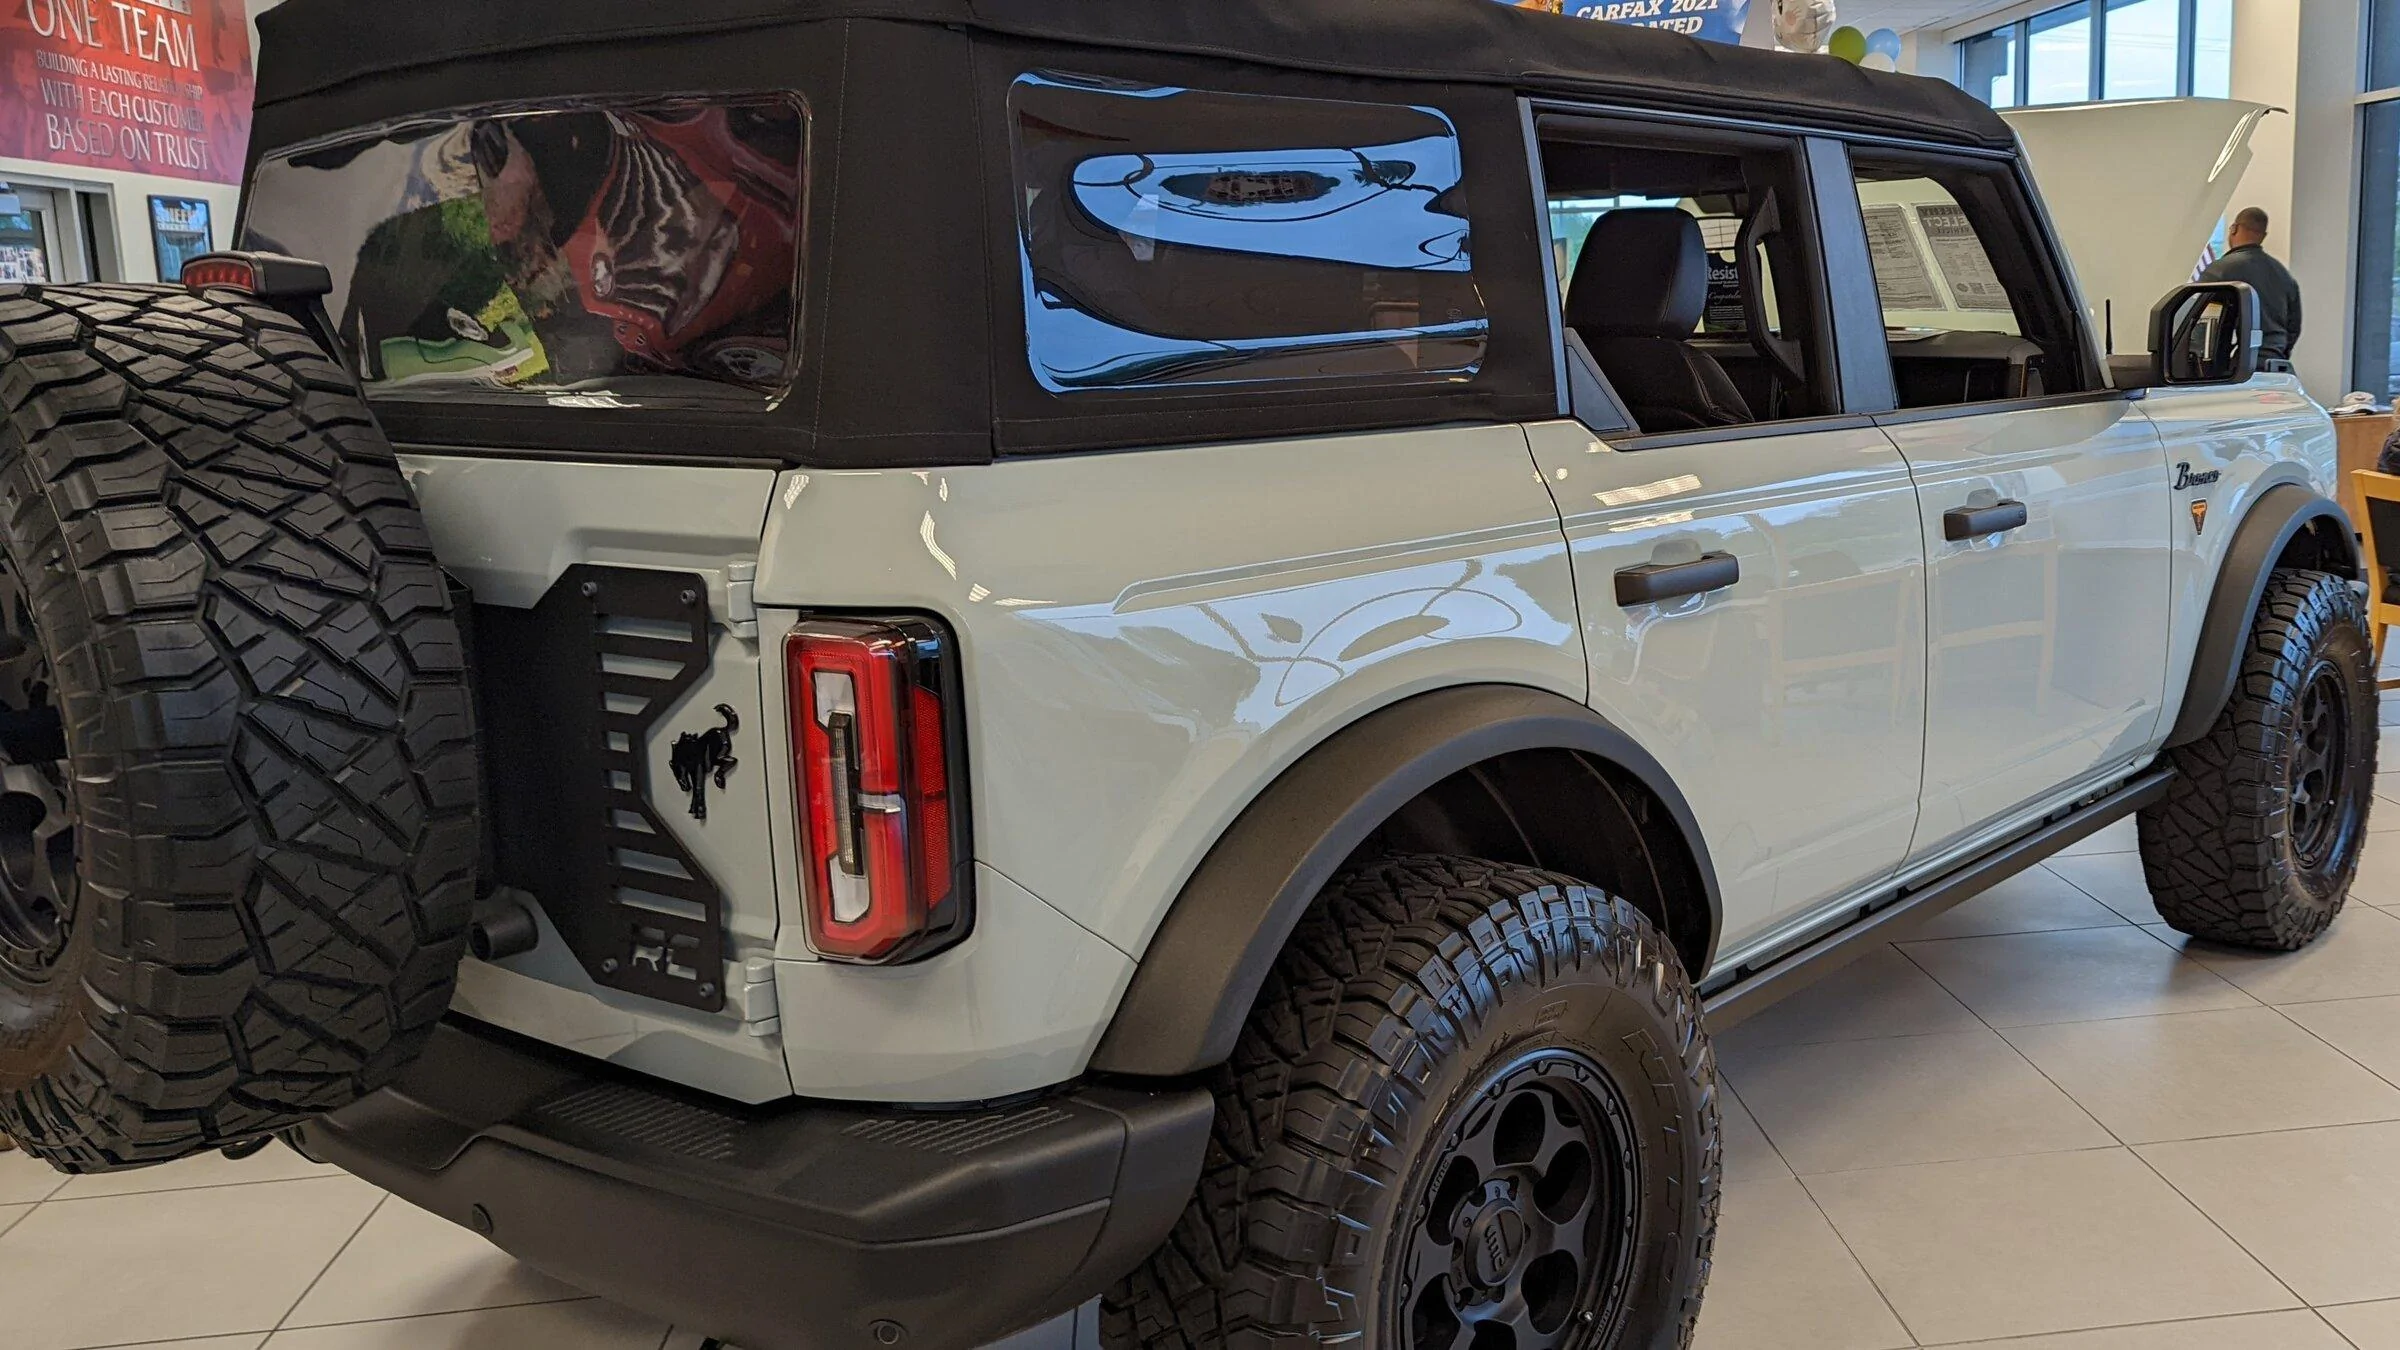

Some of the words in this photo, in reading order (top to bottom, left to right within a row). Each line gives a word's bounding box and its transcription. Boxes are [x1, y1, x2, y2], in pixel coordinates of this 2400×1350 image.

[27, 0, 103, 48] ONE
[112, 1, 200, 72] TEAM
[1576, 0, 1664, 21] CARFAX
[1669, 0, 1719, 14] 2021
[1631, 16, 1704, 35] TED
[36, 50, 88, 78] BUILDING
[91, 62, 100, 80] A
[100, 63, 142, 89] LASTING
[143, 73, 203, 101] RELATSHIP
[40, 77, 84, 110] WITH
[88, 87, 132, 121] EACH
[132, 96, 206, 132] CUSTOMER
[46, 114, 114, 157] BASED
[120, 126, 151, 161] ON
[152, 131, 208, 170] TRUST
[2173, 461, 2221, 490] Bronco
